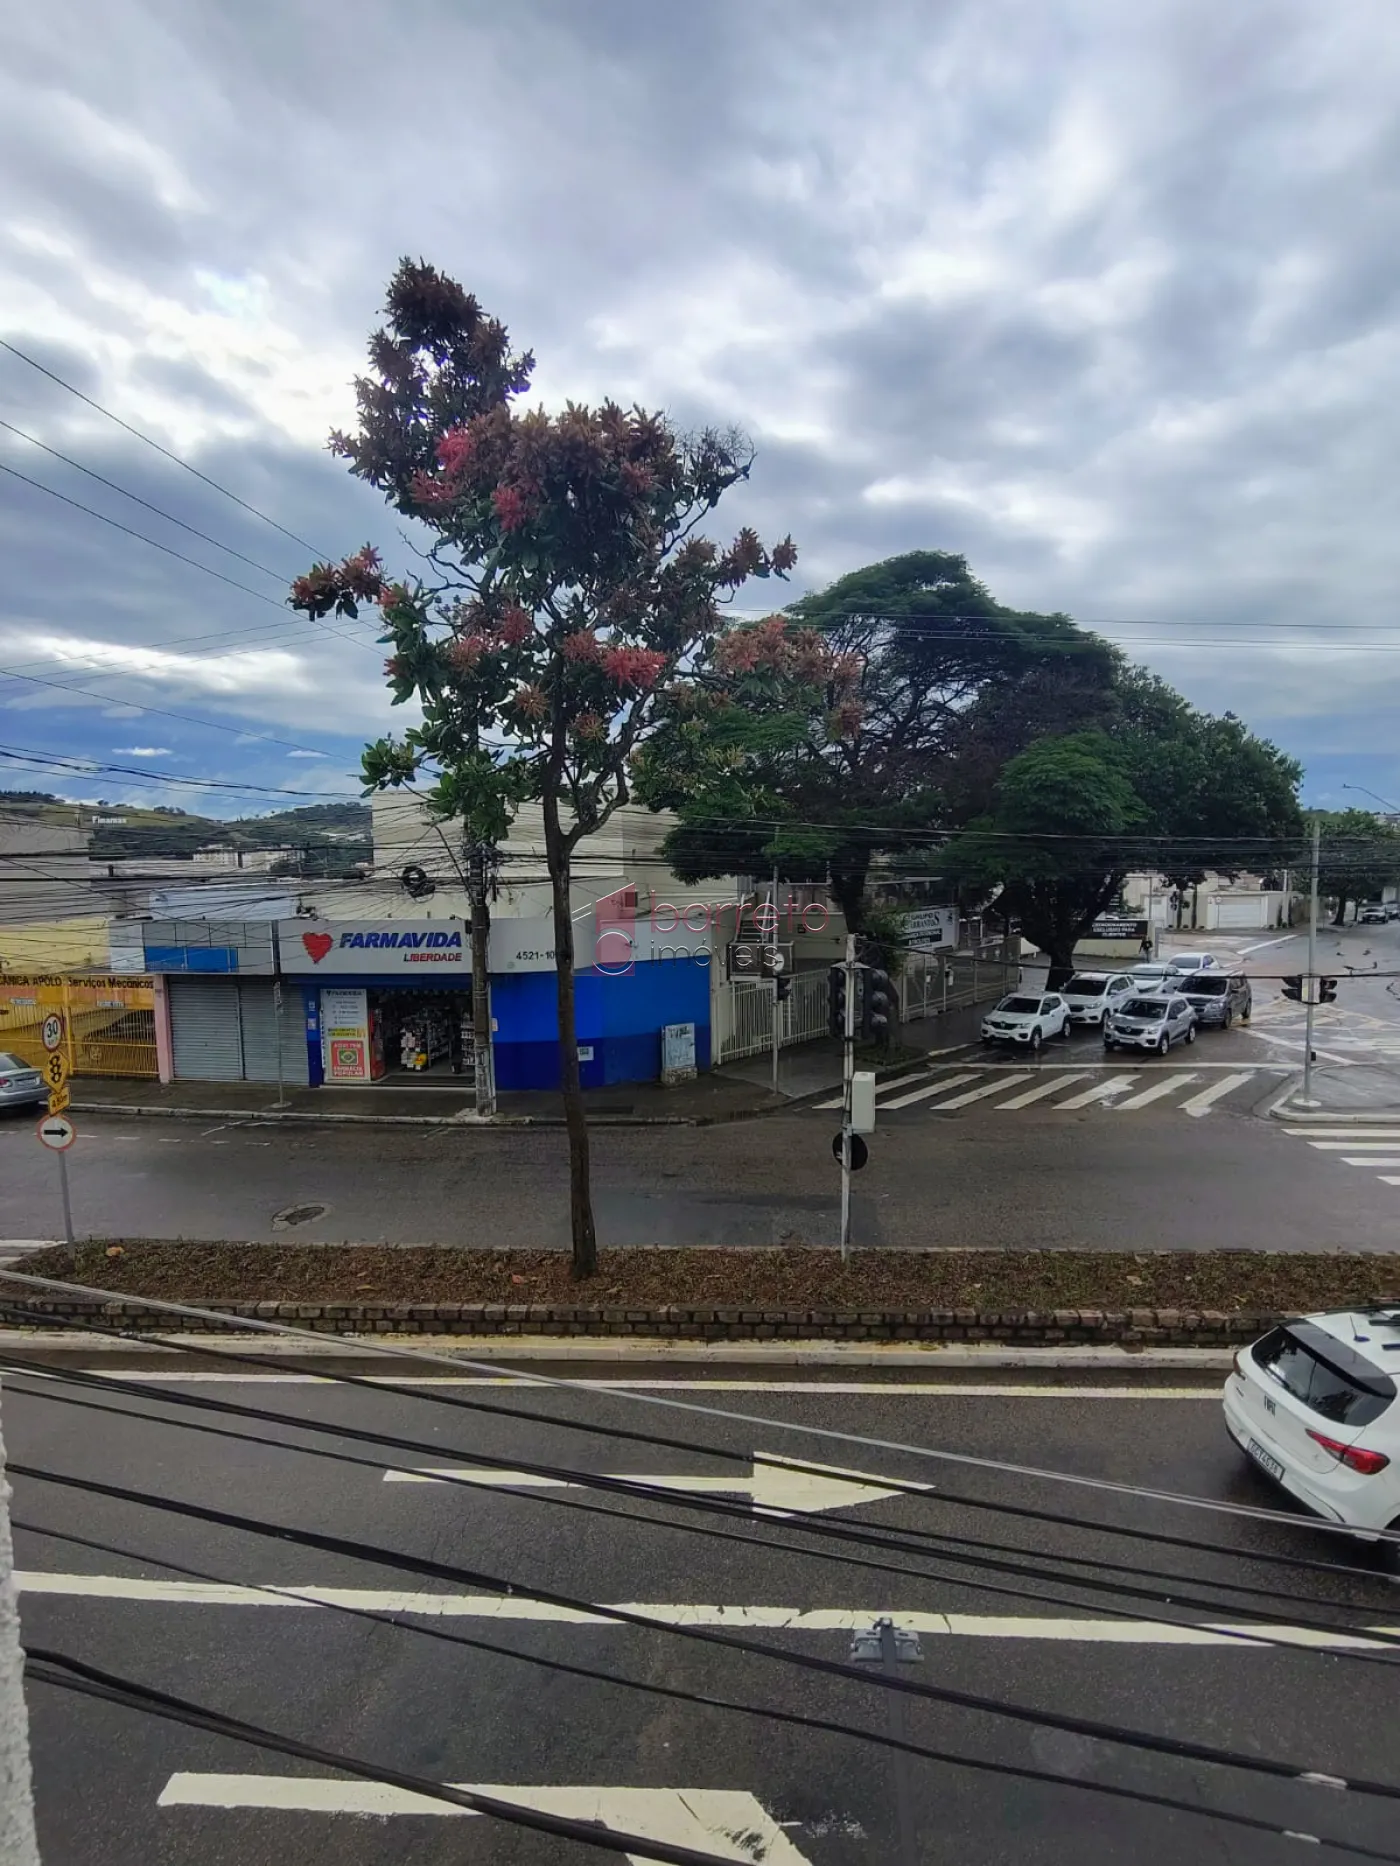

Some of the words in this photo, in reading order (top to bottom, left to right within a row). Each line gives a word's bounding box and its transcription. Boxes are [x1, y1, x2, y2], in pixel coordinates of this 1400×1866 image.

[339, 931, 462, 949] FARMAVIDA
[403, 953, 463, 962] LIBERDADE
[46, 1019, 59, 1039] 30
